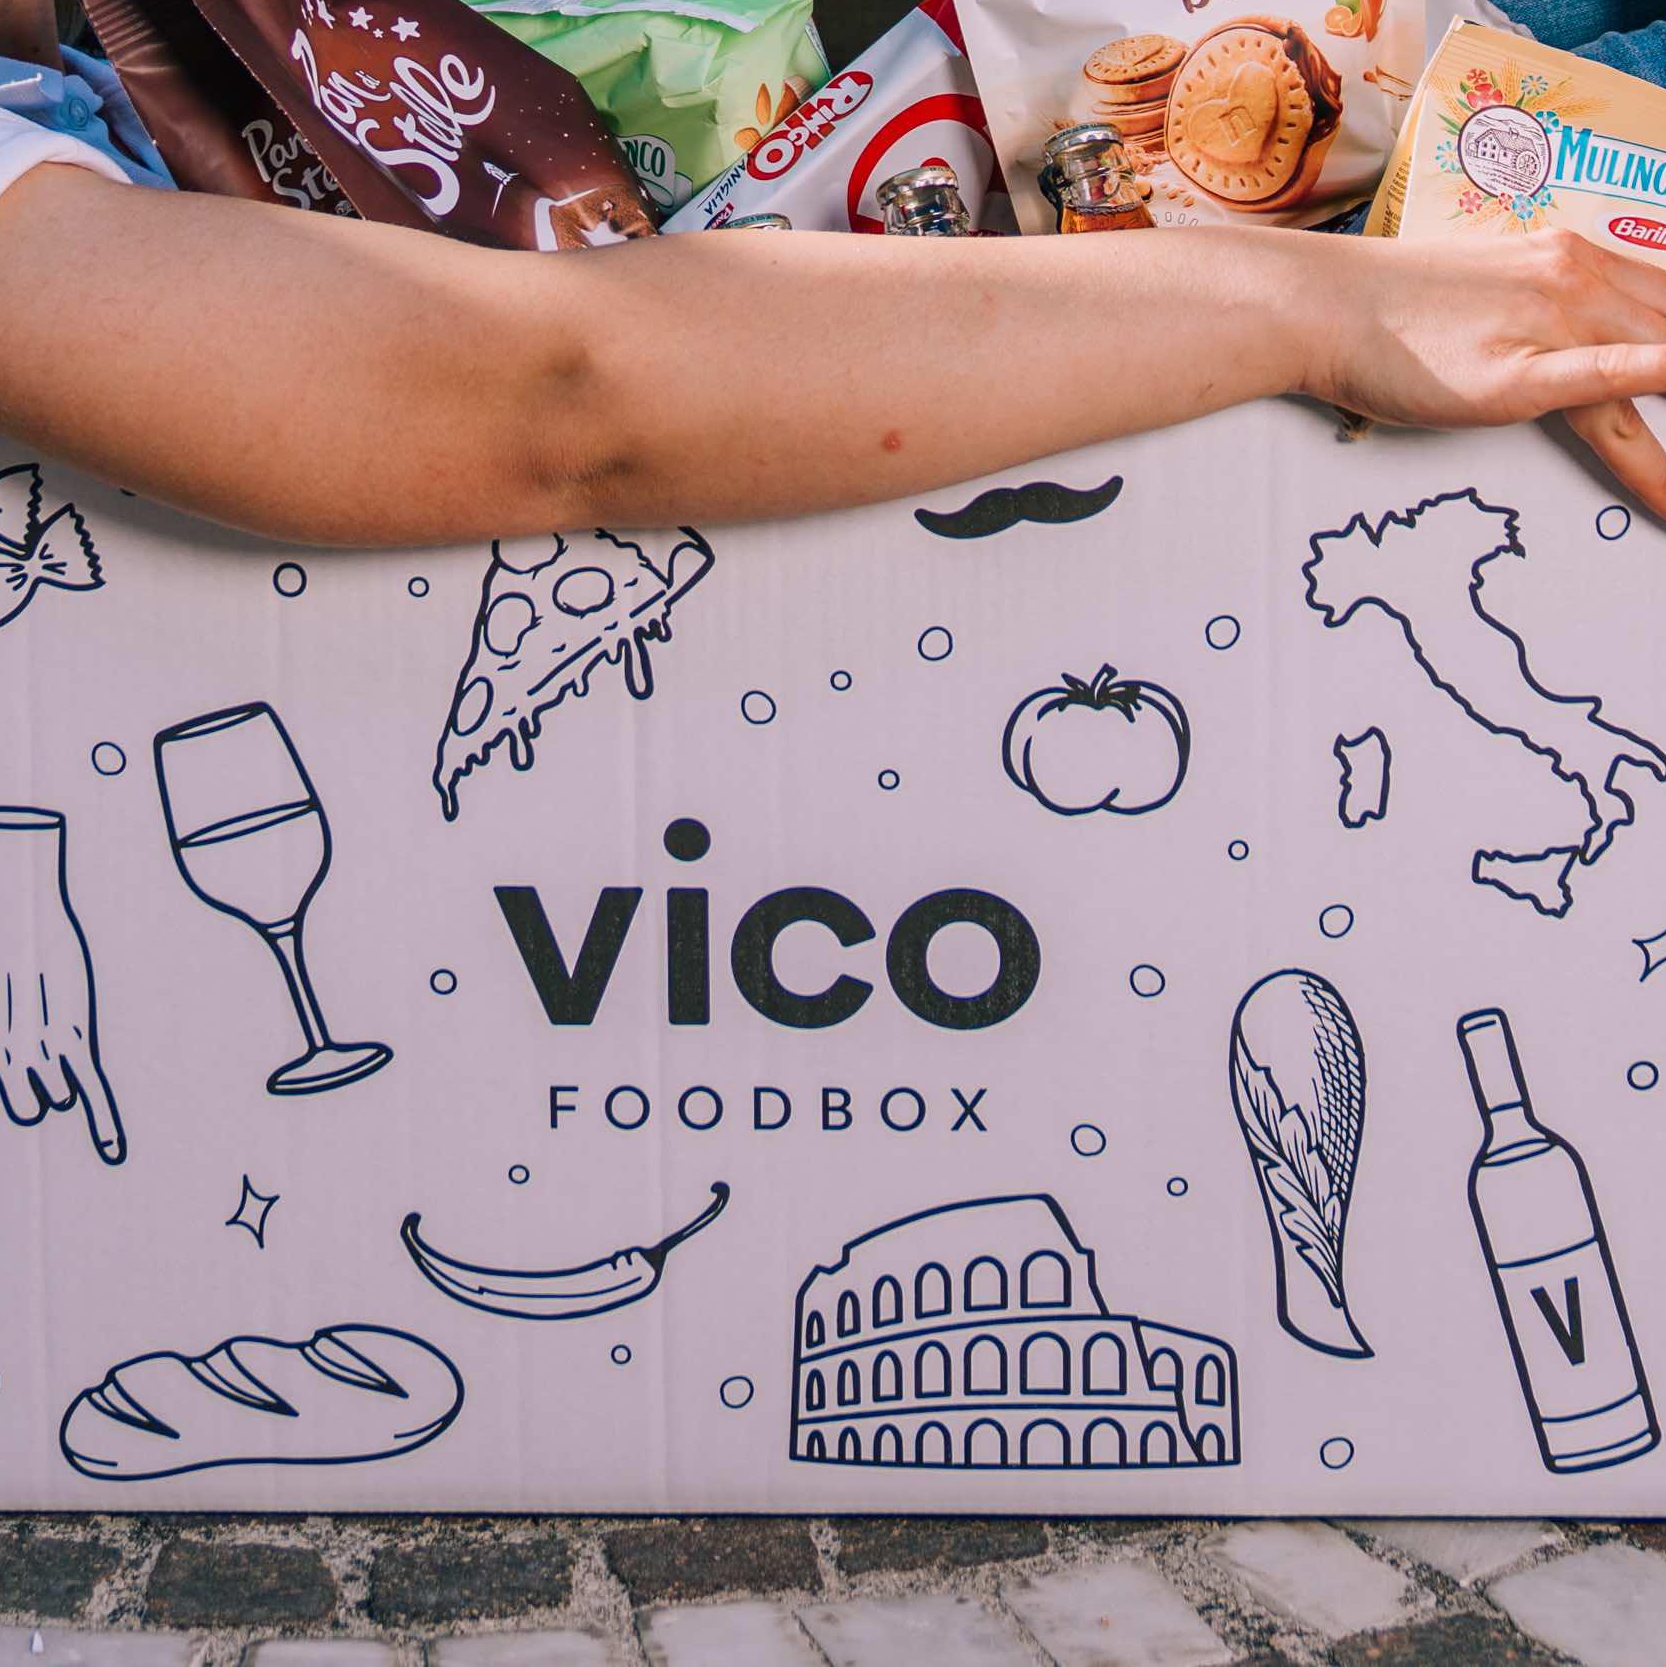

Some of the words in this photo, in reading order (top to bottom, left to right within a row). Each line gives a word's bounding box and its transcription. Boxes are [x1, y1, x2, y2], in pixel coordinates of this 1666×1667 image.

[241, 119, 313, 183] Pan
[749, 74, 867, 178] RINGO
[705, 158, 748, 216] ANIGLIA
[493, 817, 1042, 1031] vico
[548, 1084, 988, 1131] FOODBOX
[1529, 1274, 1587, 1368] V
